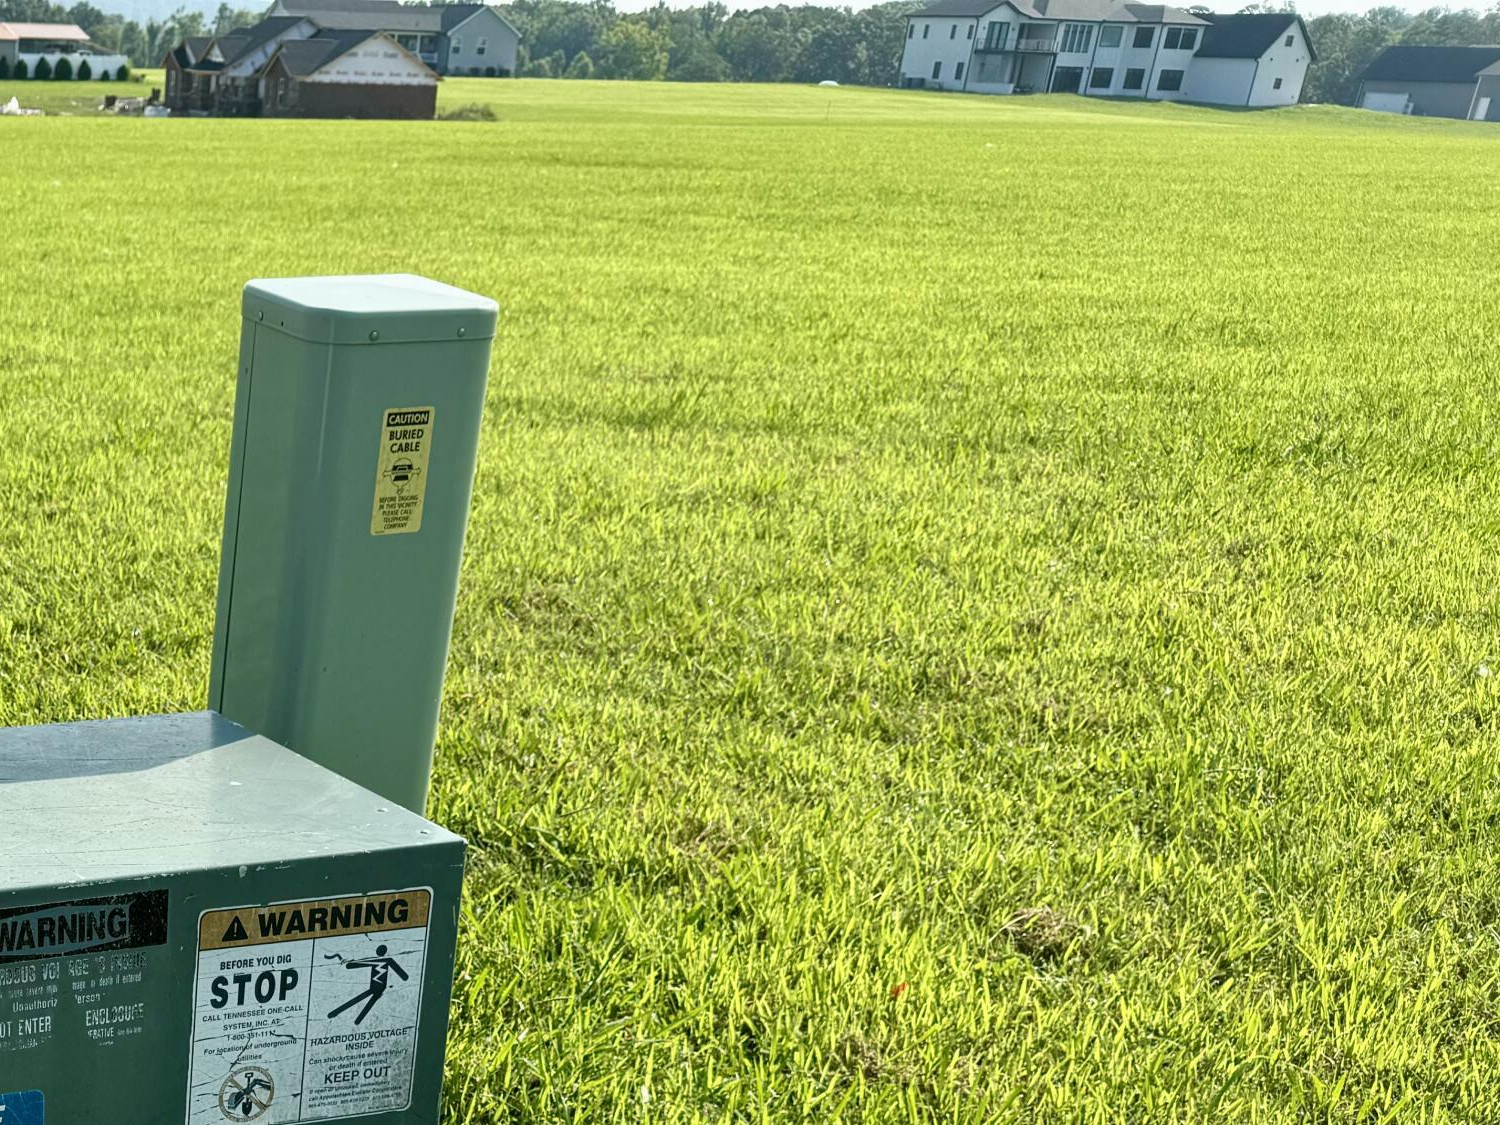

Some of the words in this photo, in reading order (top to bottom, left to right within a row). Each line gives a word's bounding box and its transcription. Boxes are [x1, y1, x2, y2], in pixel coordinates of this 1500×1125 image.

[389, 413, 428, 424] CAUTION
[389, 429, 424, 441] BURIED
[390, 442, 421, 453] CABLE
[258, 899, 410, 937] WARNING
[220, 958, 254, 971] BEFORE
[256, 956, 275, 967] YOU
[277, 954, 292, 964] DIG
[210, 969, 299, 1009] STOP
[202, 1014, 221, 1022] CALL
[223, 1009, 266, 1019] TENNESSEE
[267, 1005, 304, 1015] ONE-CALL
[18, 1015, 52, 1036] ENTER
[310, 1033, 368, 1046] HAZARDOUS
[369, 1028, 408, 1039] VOLTAGE
[216, 1045, 244, 1055] location
[254, 1040, 297, 1050] underground
[345, 1041, 375, 1050] INSIDE
[237, 1053, 262, 1061] utilities
[309, 1057, 322, 1065] Can
[324, 1070, 360, 1084] KEEP
[363, 1066, 391, 1080] OUT
